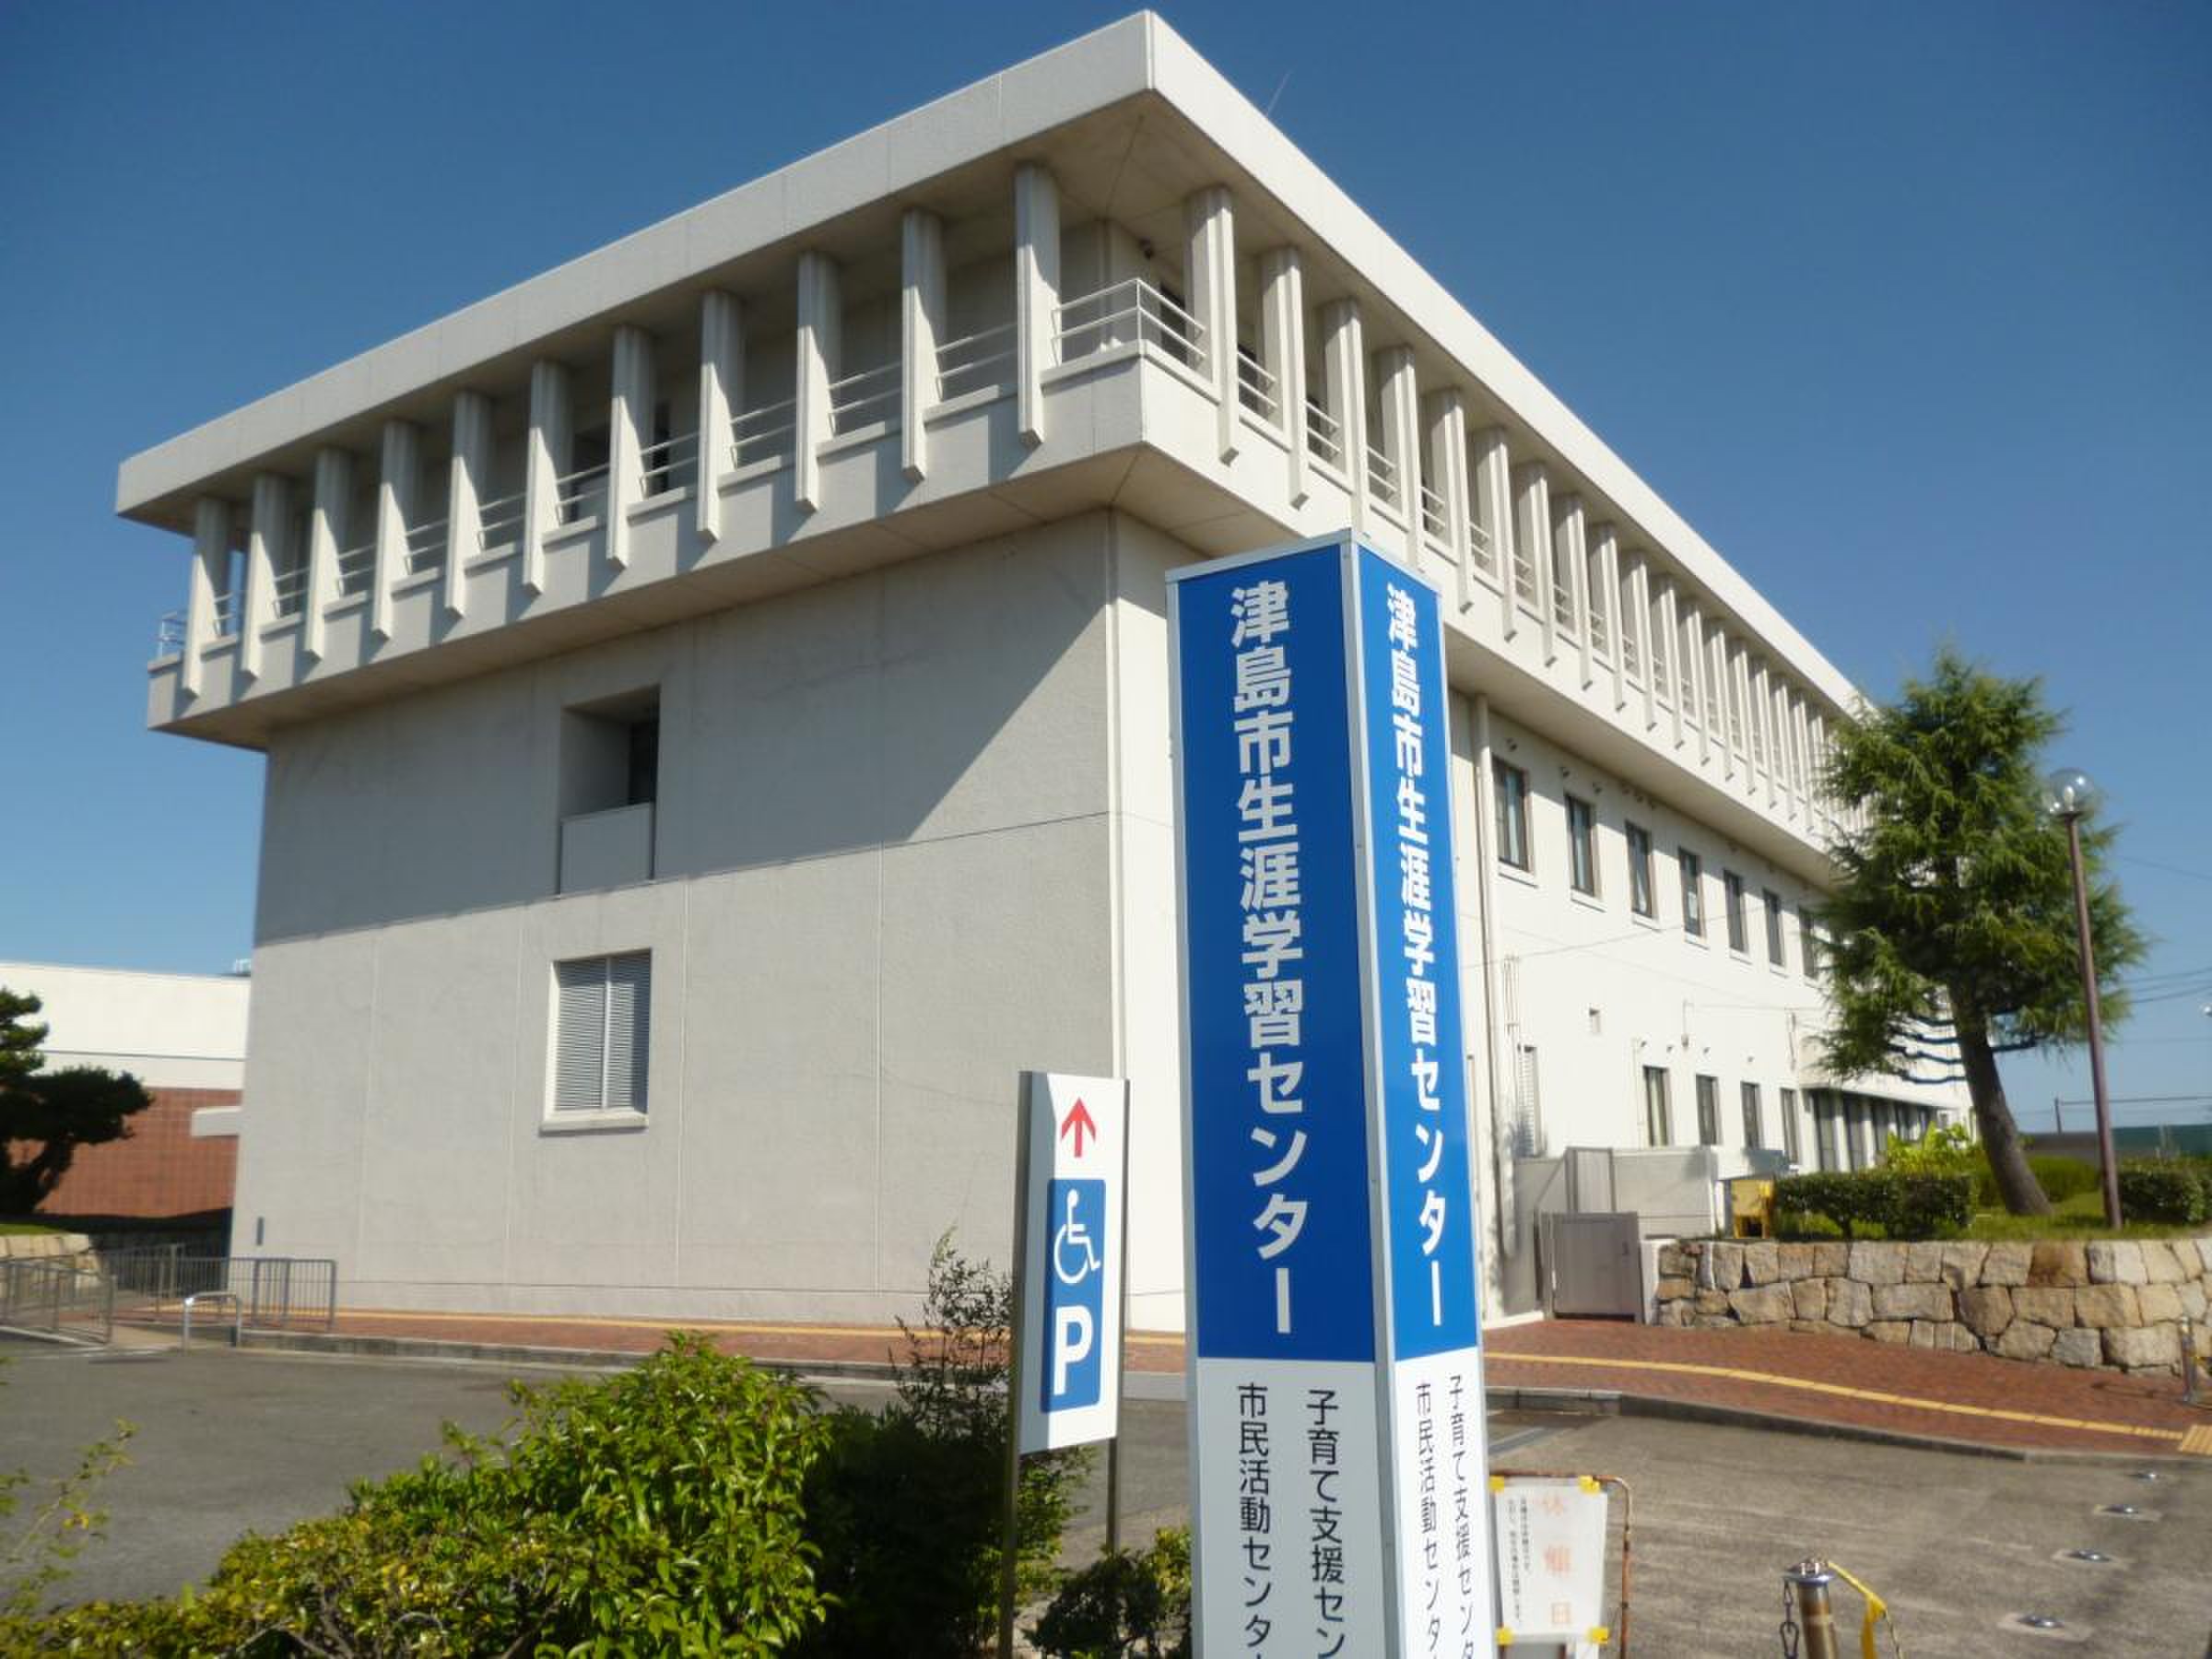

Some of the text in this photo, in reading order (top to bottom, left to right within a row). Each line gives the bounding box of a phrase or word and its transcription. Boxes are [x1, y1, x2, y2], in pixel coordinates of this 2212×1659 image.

[1230, 580, 1308, 1335] 津島市生涯学習センター
[1386, 584, 1446, 1327] 津島市生涯学習センター
[1053, 1304, 1094, 1396] P
[1238, 1382, 1272, 1659] 市民活動センタ
[1416, 1382, 1441, 1659] 市民活動センタ
